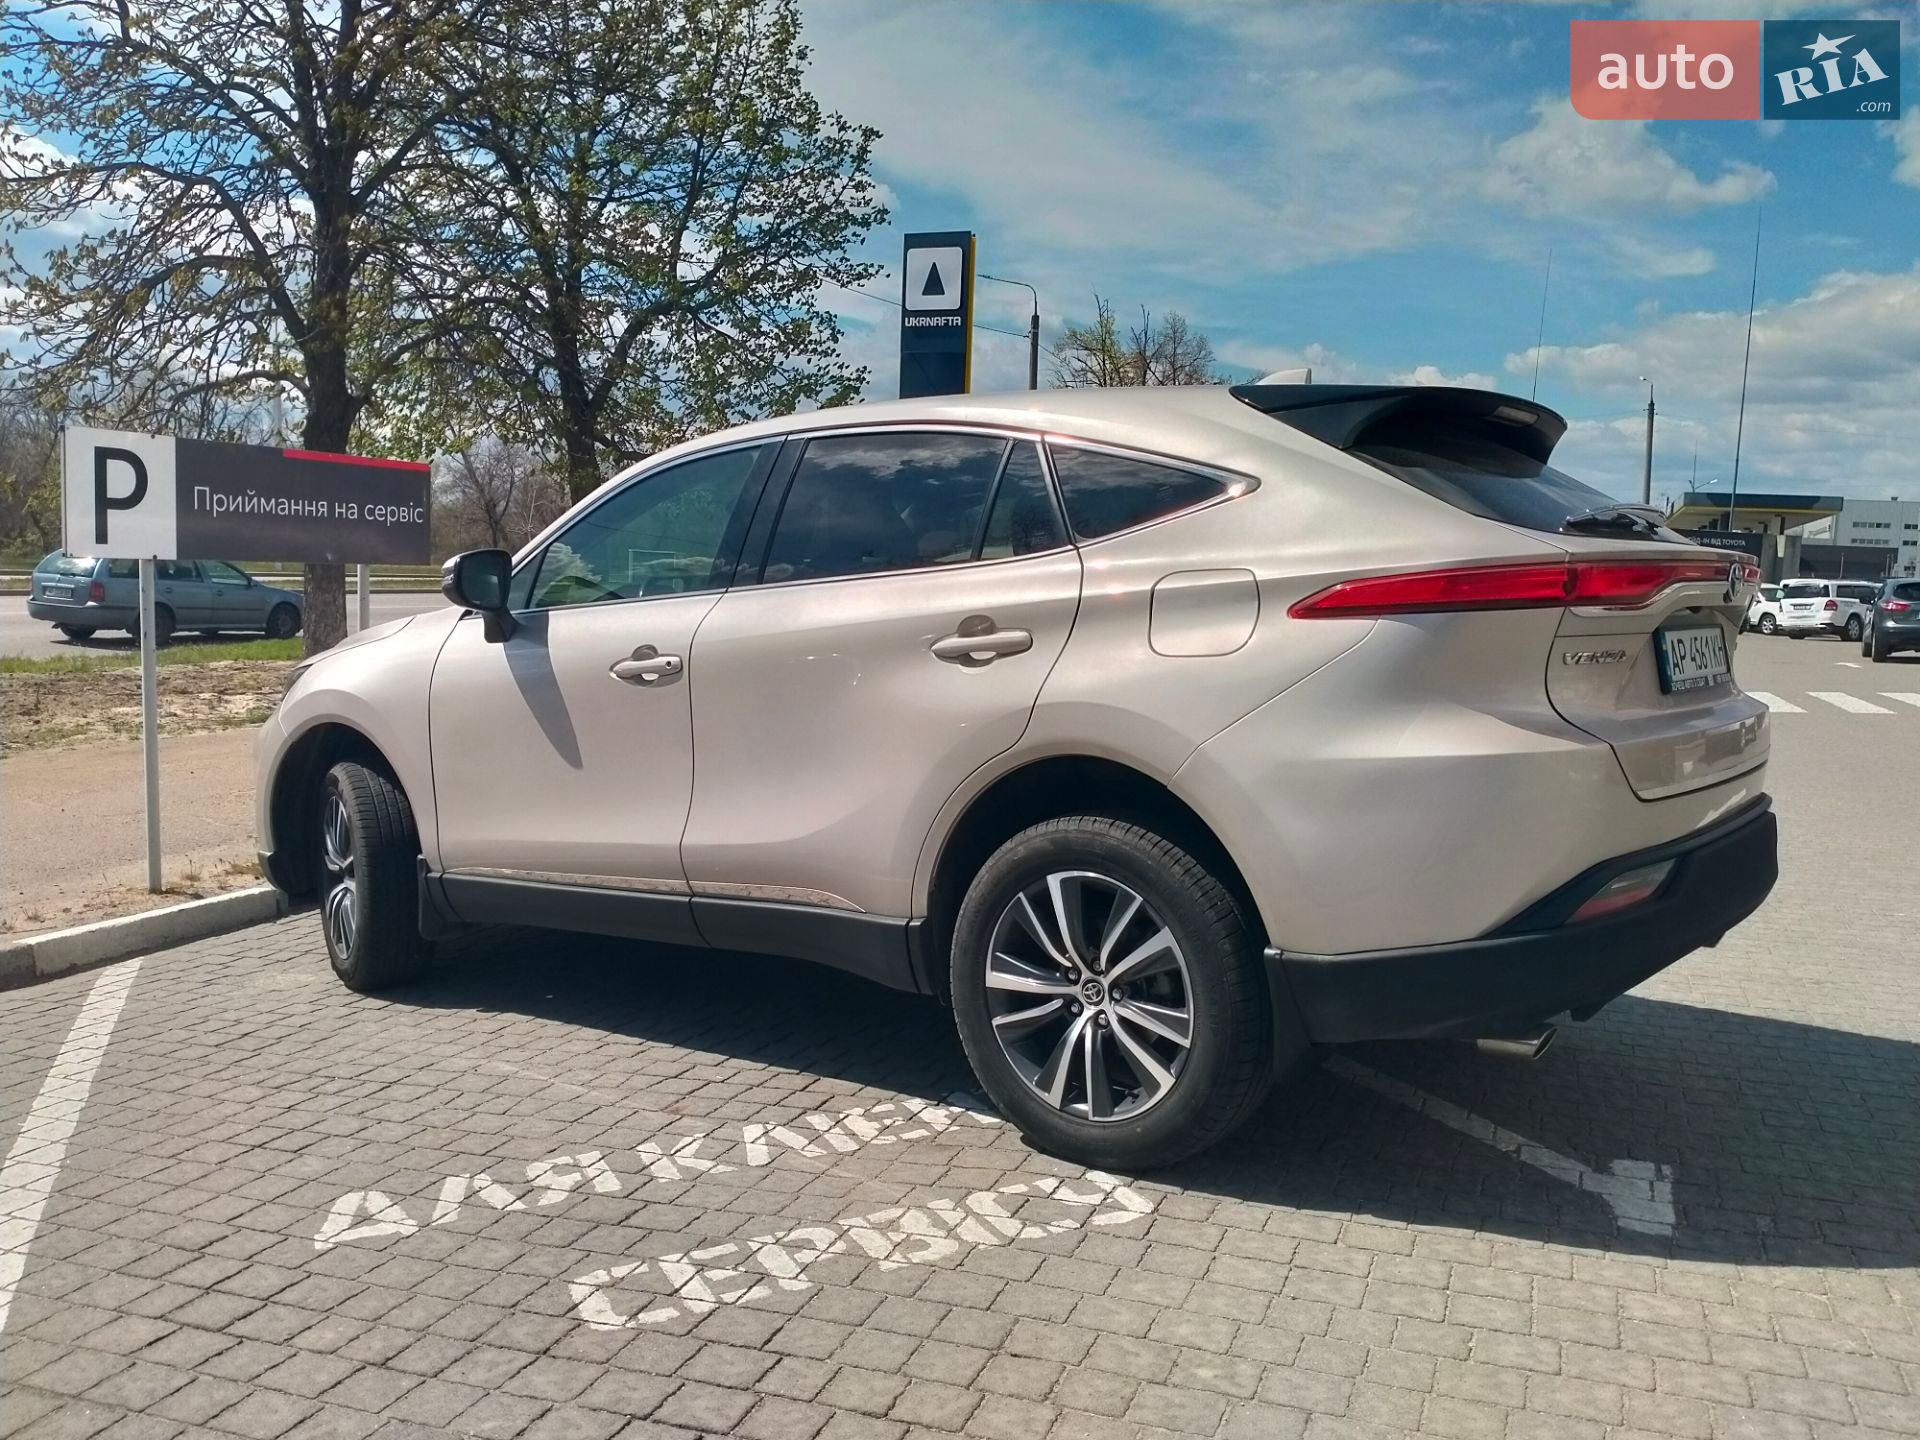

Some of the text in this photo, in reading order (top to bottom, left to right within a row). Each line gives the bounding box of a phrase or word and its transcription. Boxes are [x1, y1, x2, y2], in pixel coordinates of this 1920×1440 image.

[904, 316, 962, 327] UKRNAFTA
[93, 445, 149, 545] P
[193, 486, 424, 527] Приймання на сервіс
[1722, 538, 1746, 547] TOYOTA
[1670, 638, 1687, 676] AP
[1689, 635, 1714, 671] 4561
[314, 1089, 1003, 1249] ДЛЯ КЛІЄН
[568, 1169, 1156, 1332] СЕРВІСУ
